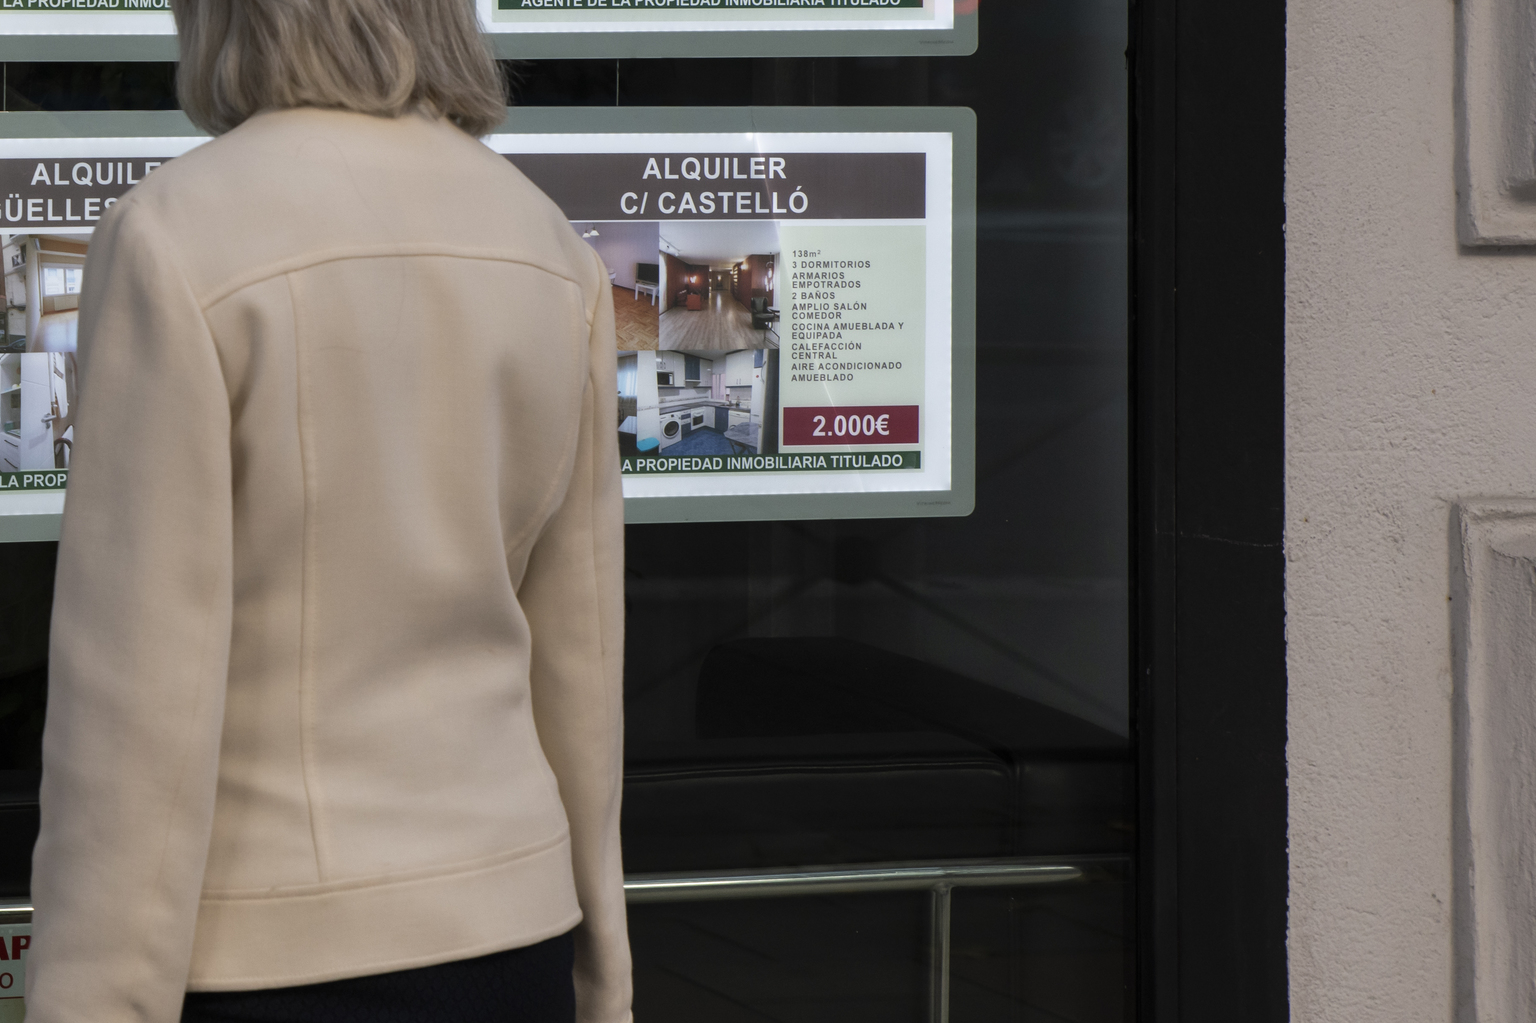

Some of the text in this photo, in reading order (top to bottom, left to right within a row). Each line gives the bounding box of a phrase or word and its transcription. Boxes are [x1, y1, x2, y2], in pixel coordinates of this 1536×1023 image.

[642, 157, 786, 181] ALQUILER
[621, 186, 808, 214] C/ CASTELLÓ
[792, 272, 845, 280] ARMARIOS
[792, 280, 861, 289] EMPOTRADOS
[792, 301, 867, 311] AMPLIO SALÓN
[792, 312, 842, 320] COMEDOR
[792, 341, 862, 351] CALEFACCIÓN
[791, 361, 902, 371] AIRE ACONDICIONADO
[791, 373, 854, 382] AMUEBLADO
[813, 414, 890, 436] 2.000€
[637, 457, 722, 471] PROPIEDAD
[727, 456, 827, 470] INMOBILIARIA
[830, 454, 903, 468] TITULADO
[0, 475, 19, 488] LA
